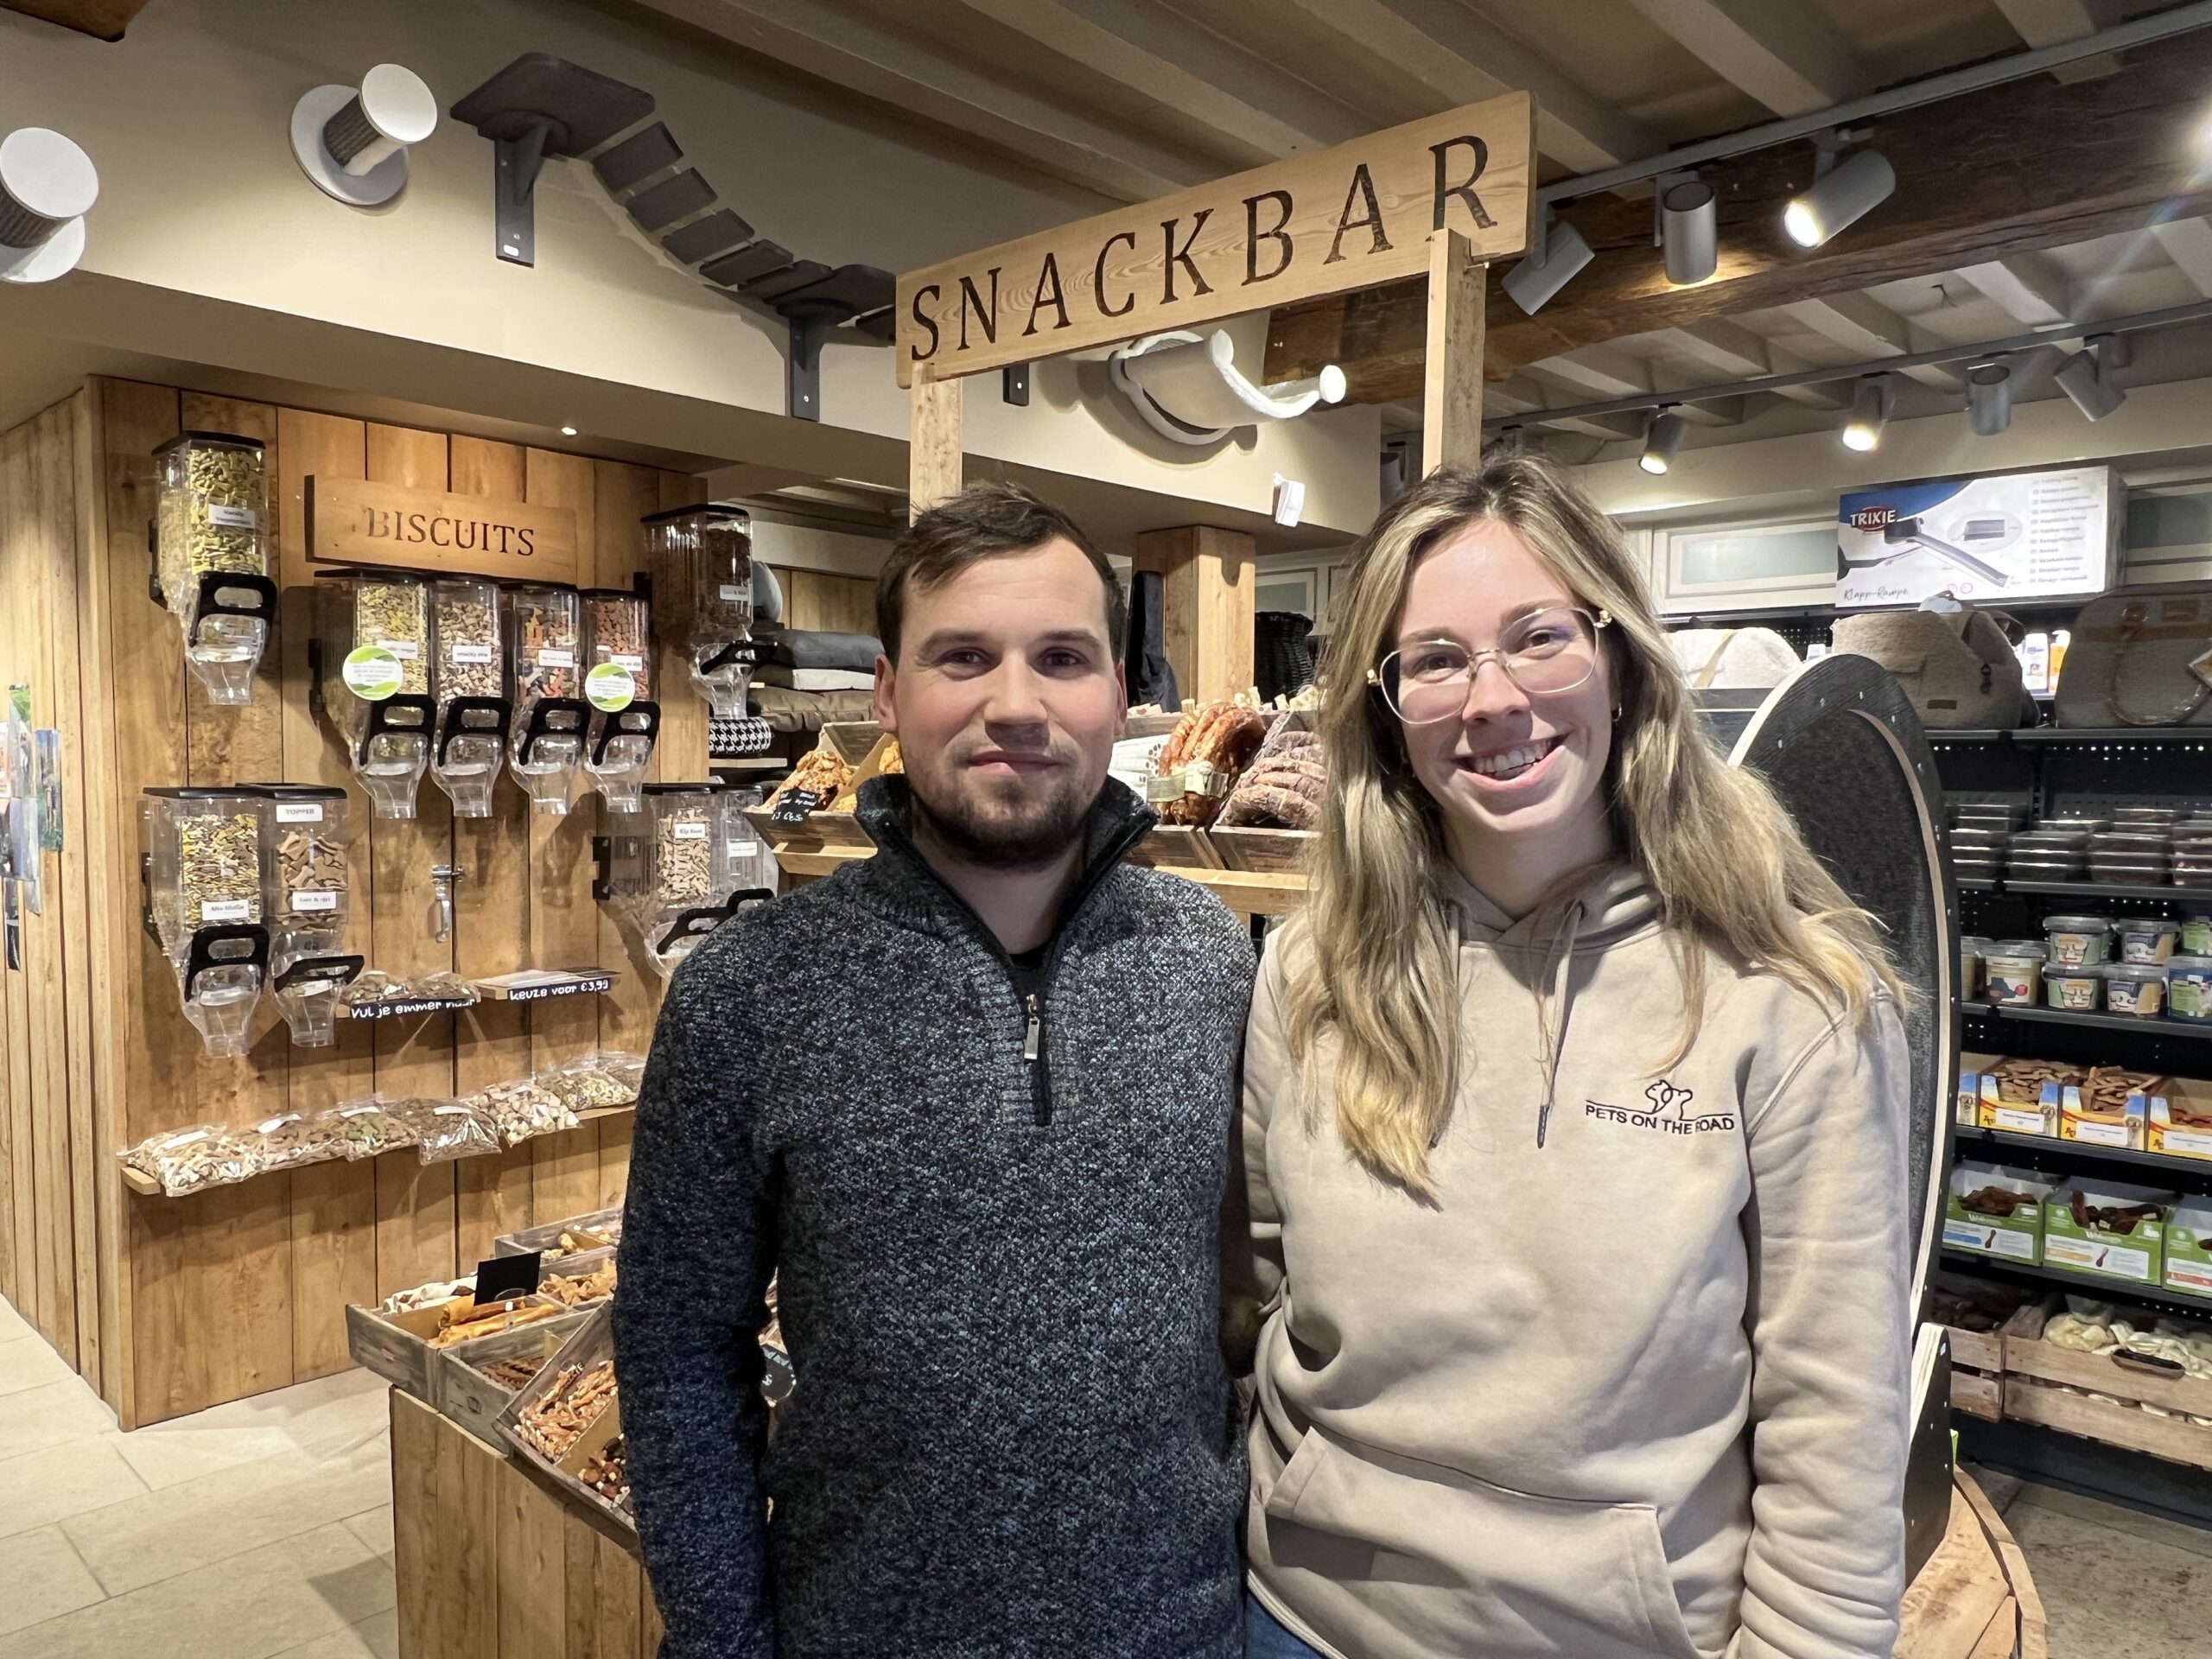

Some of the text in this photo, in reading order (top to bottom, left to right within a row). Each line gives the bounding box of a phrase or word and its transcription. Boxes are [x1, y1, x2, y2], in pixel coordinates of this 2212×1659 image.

[911, 135, 1498, 362] SNACKBAR
[365, 506, 535, 556] BISCUITS
[509, 988, 548, 1001] keuze
[551, 985, 577, 995] voor
[351, 1007, 375, 1020] Vul
[376, 1004, 391, 1019] je
[395, 1001, 442, 1014] emmer
[1585, 1103, 1628, 1124] PETS
[1631, 1114, 1657, 1129] ON
[1662, 1119, 1694, 1135] THE
